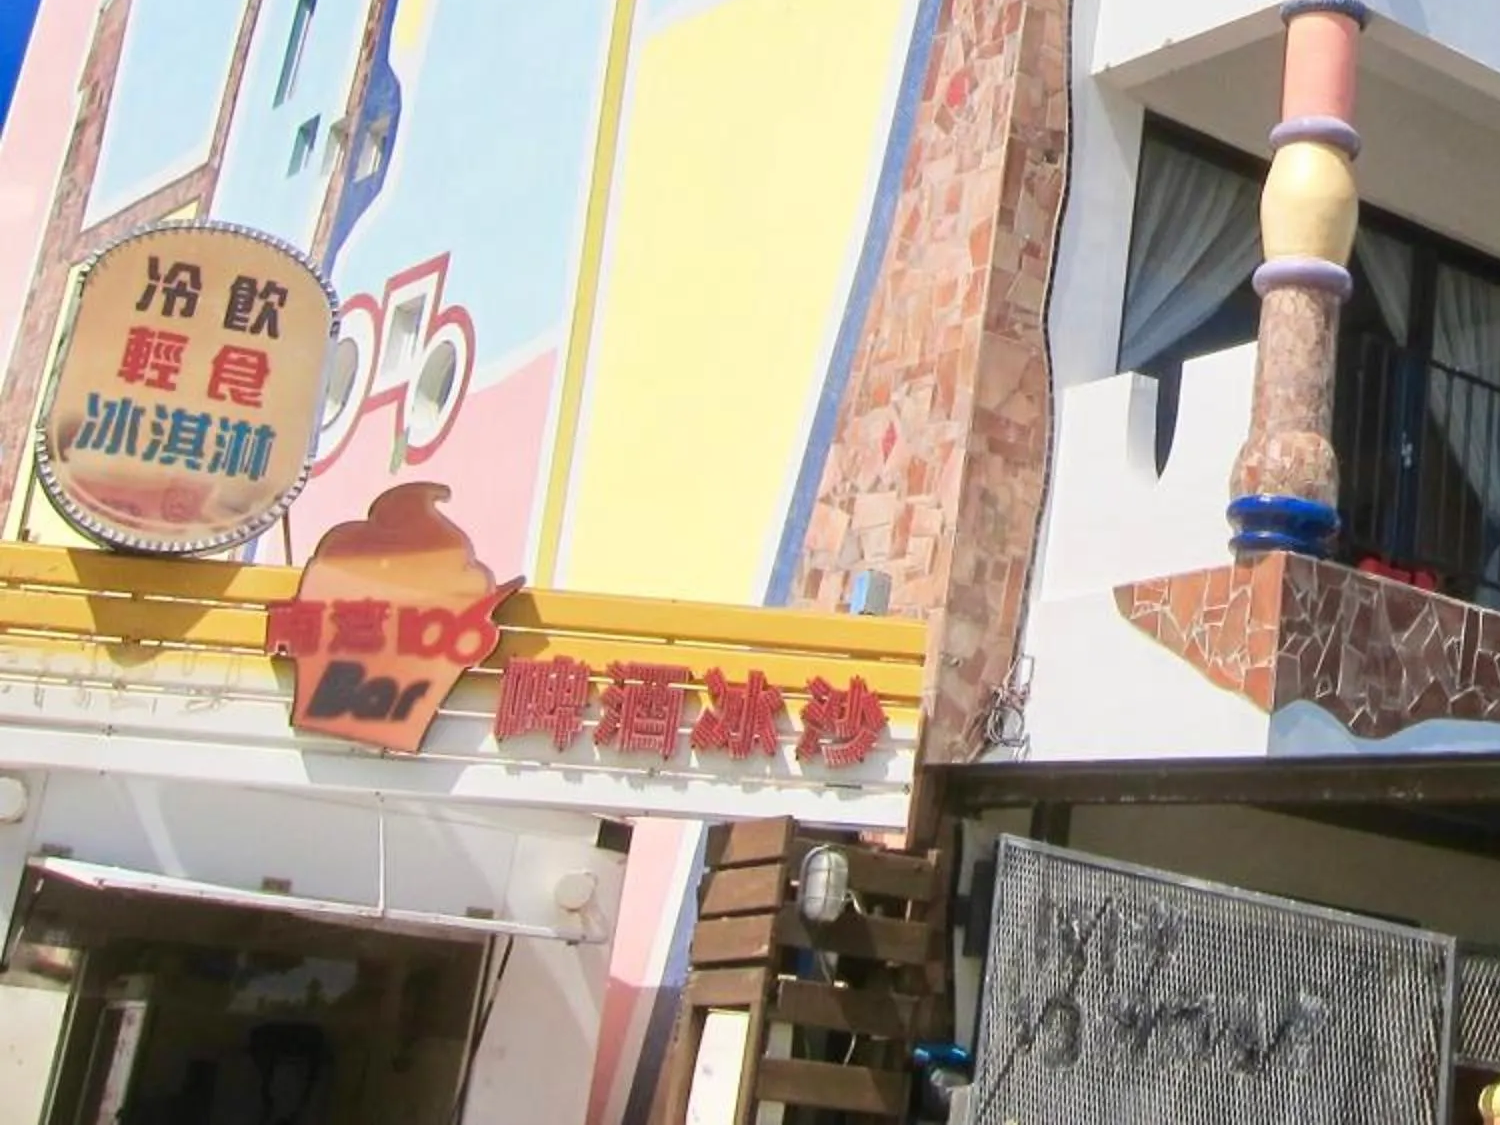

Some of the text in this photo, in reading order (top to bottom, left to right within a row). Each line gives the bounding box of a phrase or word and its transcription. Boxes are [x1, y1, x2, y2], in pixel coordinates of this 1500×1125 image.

[135, 256, 289, 340] 冷飲
[117, 326, 271, 408] 輕食
[75, 392, 277, 481] 冰淇淋
[306, 660, 433, 721] Bar
[494, 655, 888, 768] 啤酒冰沙
